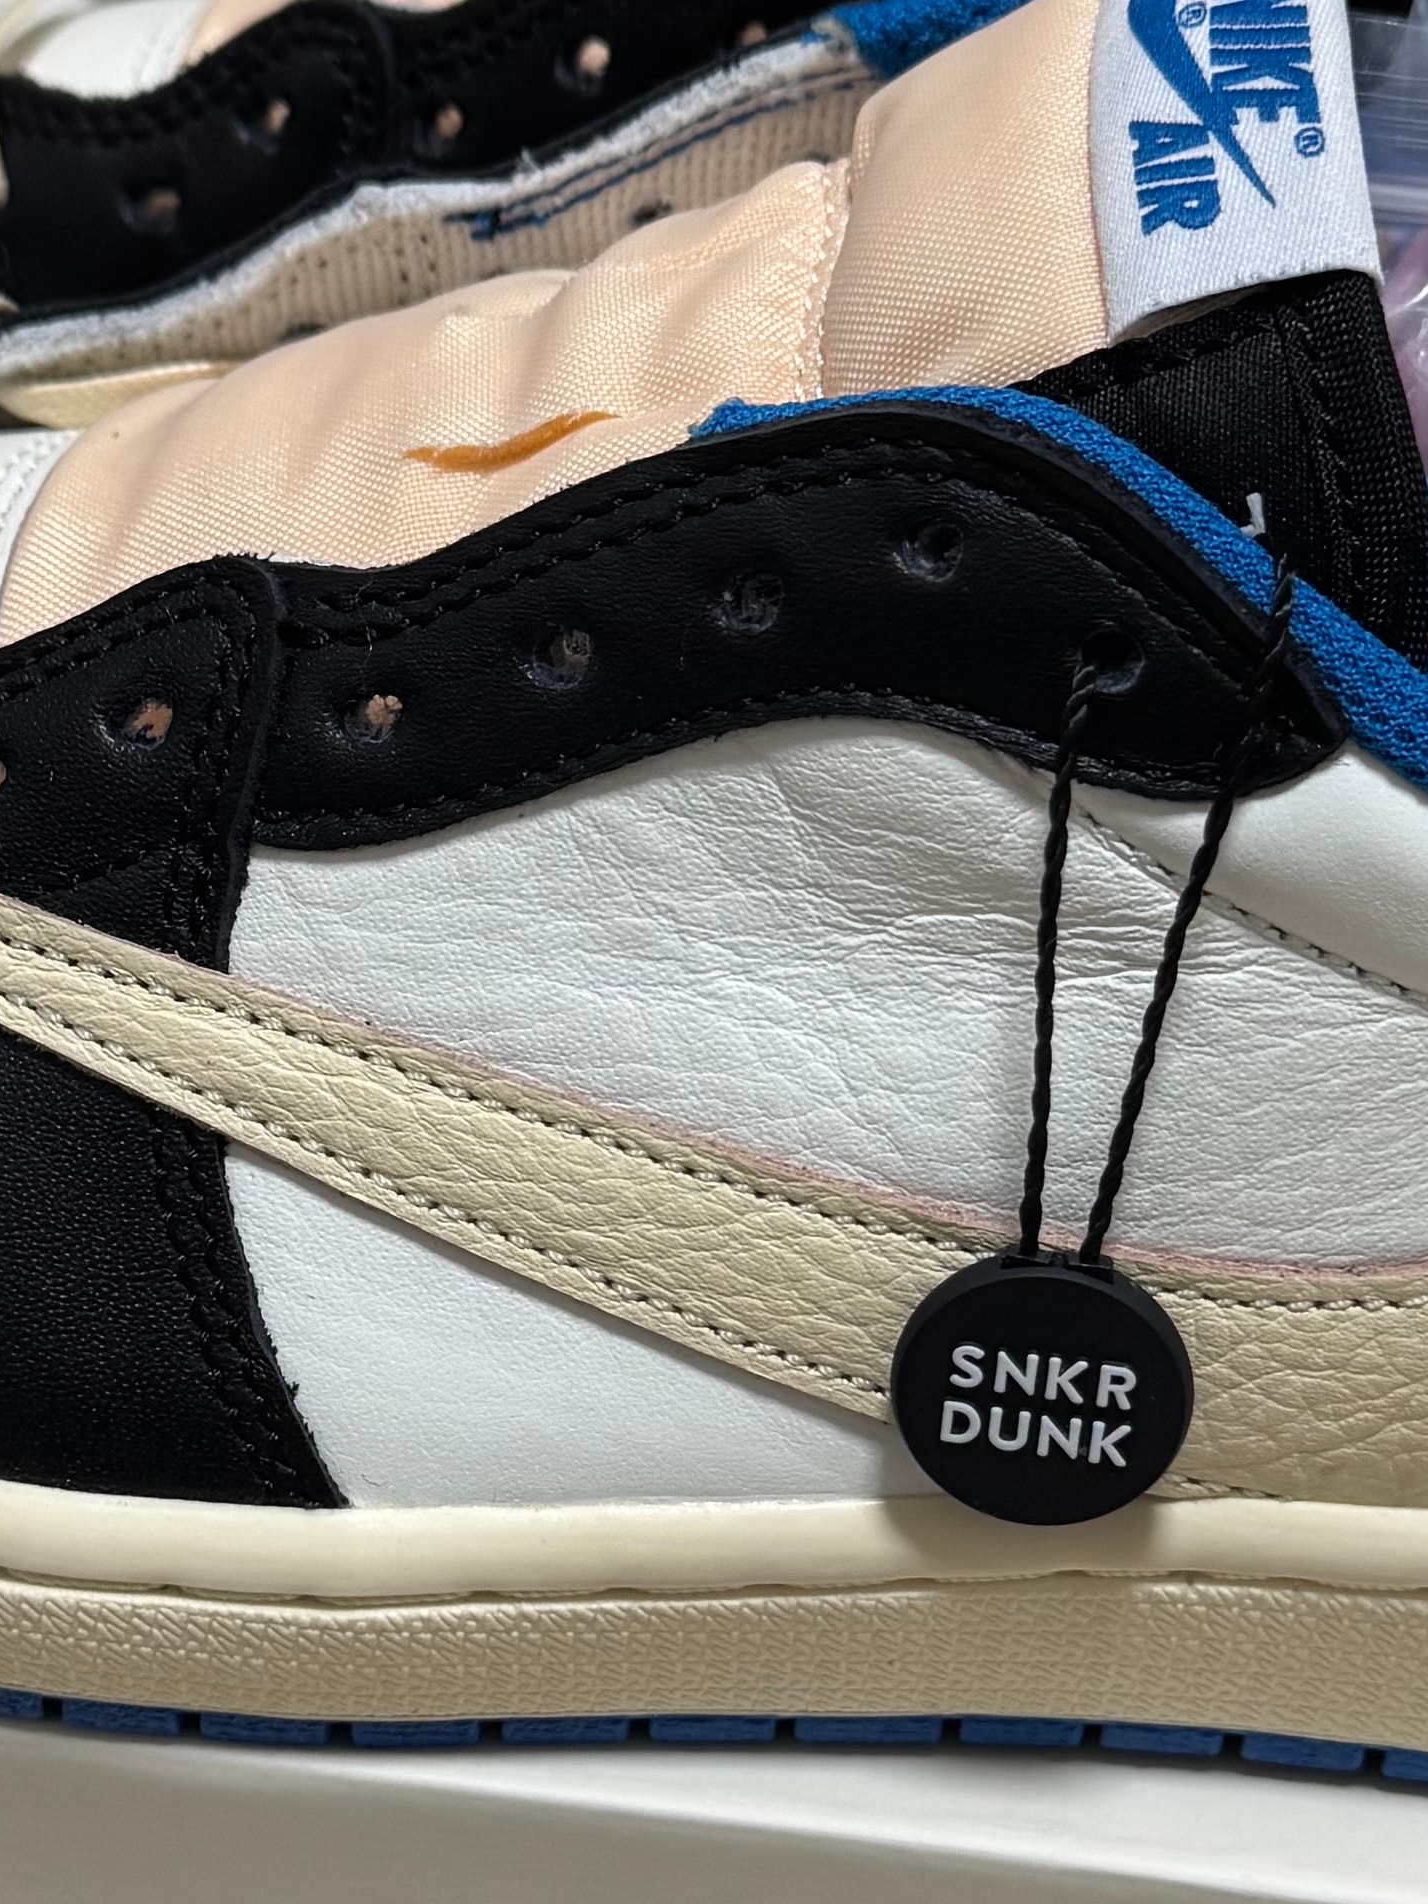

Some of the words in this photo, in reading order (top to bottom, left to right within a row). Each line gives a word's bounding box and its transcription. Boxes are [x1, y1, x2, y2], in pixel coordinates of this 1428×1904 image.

[1128, 119, 1222, 238] AIR
[949, 1344, 1137, 1411] SNKR
[939, 1399, 1132, 1468] DUNK
